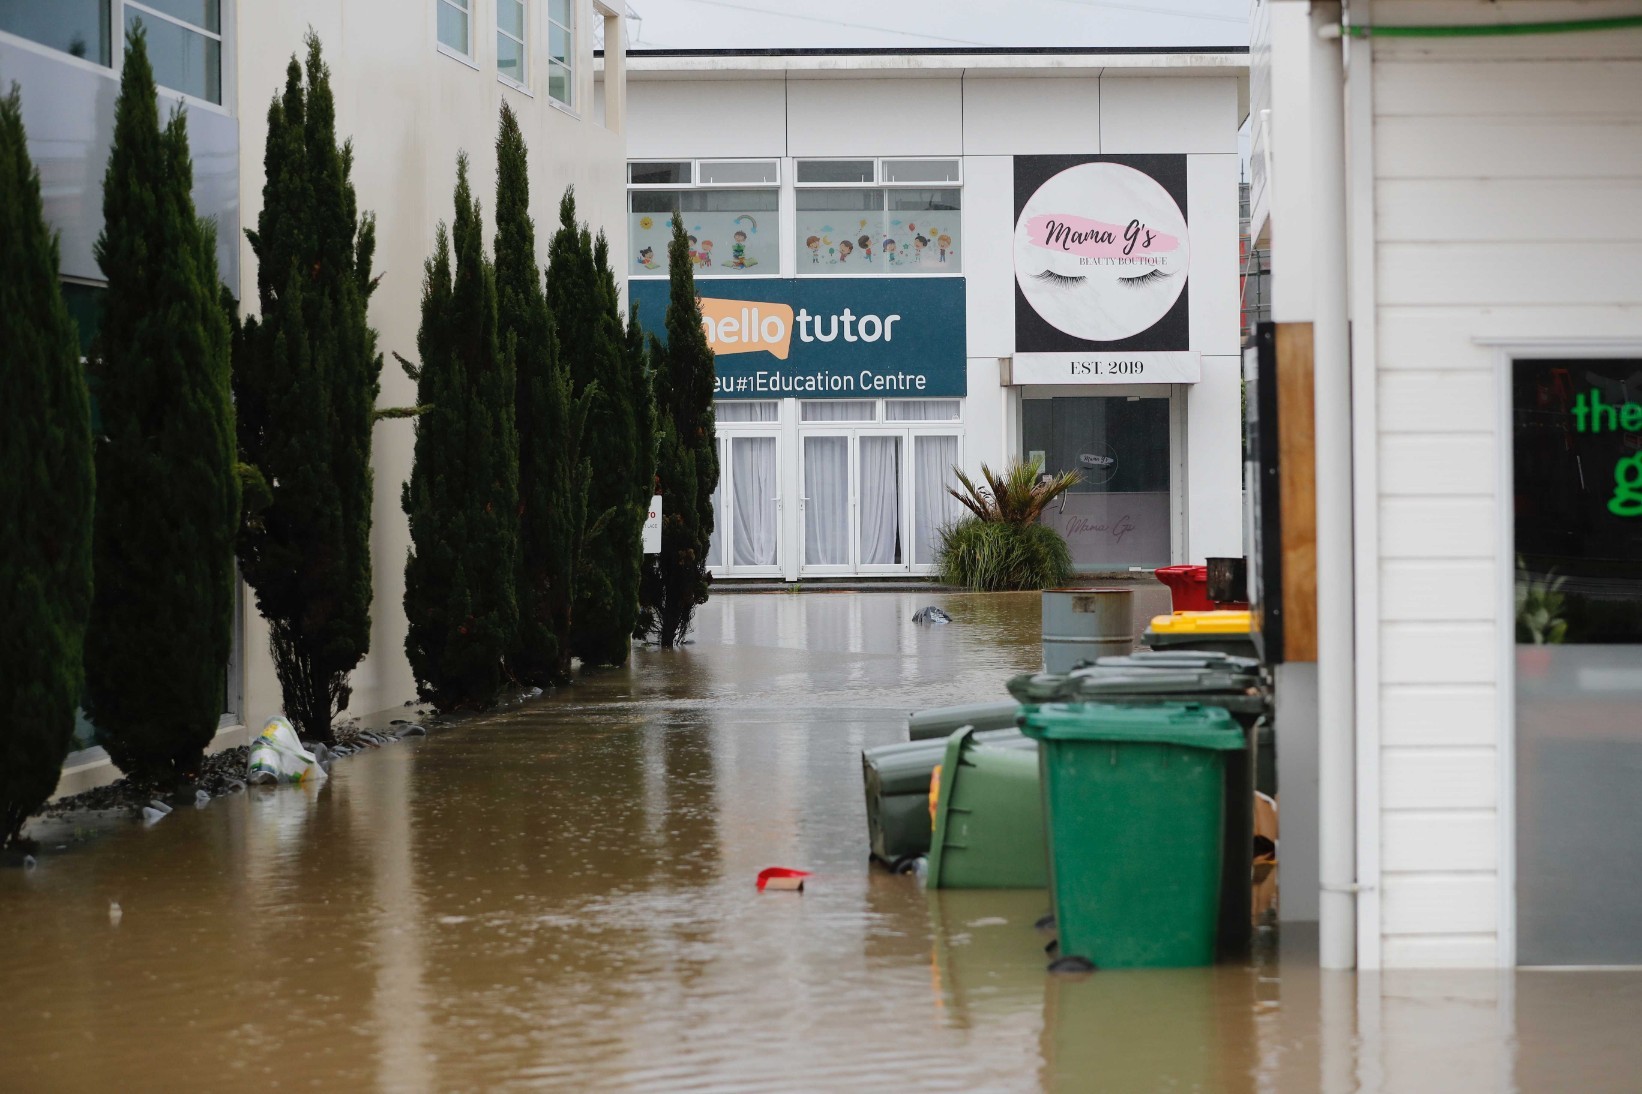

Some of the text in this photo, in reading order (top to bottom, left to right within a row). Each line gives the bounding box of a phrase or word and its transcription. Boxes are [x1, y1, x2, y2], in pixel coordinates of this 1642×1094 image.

[1045, 219, 1156, 255] Mama G's
[1079, 256, 1167, 266] BEAUTY BOUTIQUE
[796, 308, 900, 342] tutor
[1070, 361, 1144, 375] EST. 2019
[860, 370, 926, 391] Centre
[1571, 388, 1642, 432] the
[1066, 515, 1110, 538] Mama
